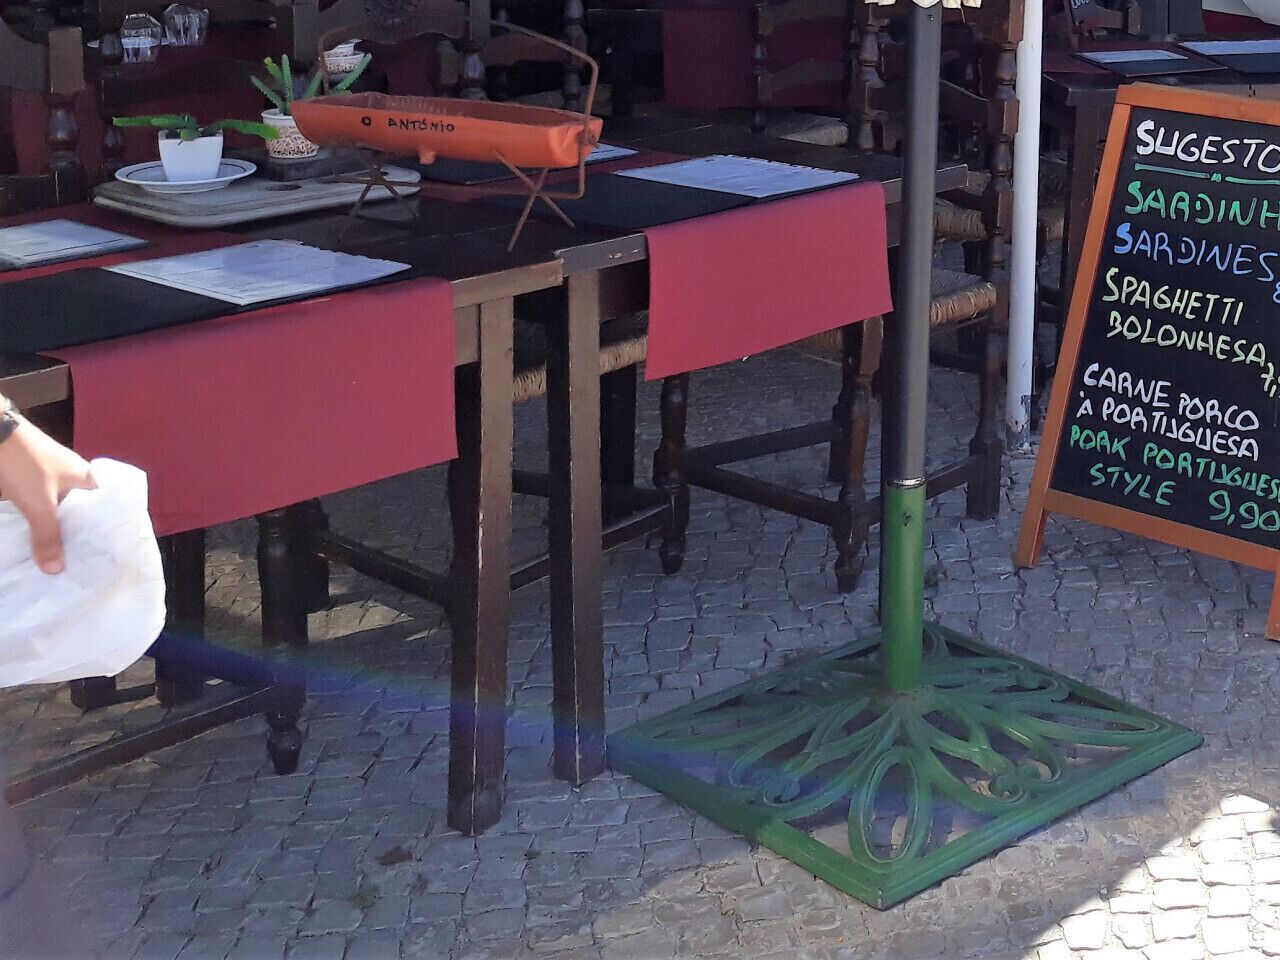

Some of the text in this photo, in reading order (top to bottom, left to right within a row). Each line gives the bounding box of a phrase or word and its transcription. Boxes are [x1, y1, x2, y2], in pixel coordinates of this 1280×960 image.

[1114, 222, 1279, 282] SARDINES
[1102, 267, 1244, 326] SPAGHETTI
[1106, 311, 1266, 367] BOLONHESA
[1083, 362, 1260, 431] CARNE PORCO
[1070, 424, 1131, 462] PORK
[1102, 397, 1259, 462] PORTUGUESA
[1089, 462, 1280, 532] STYLE 9,90
